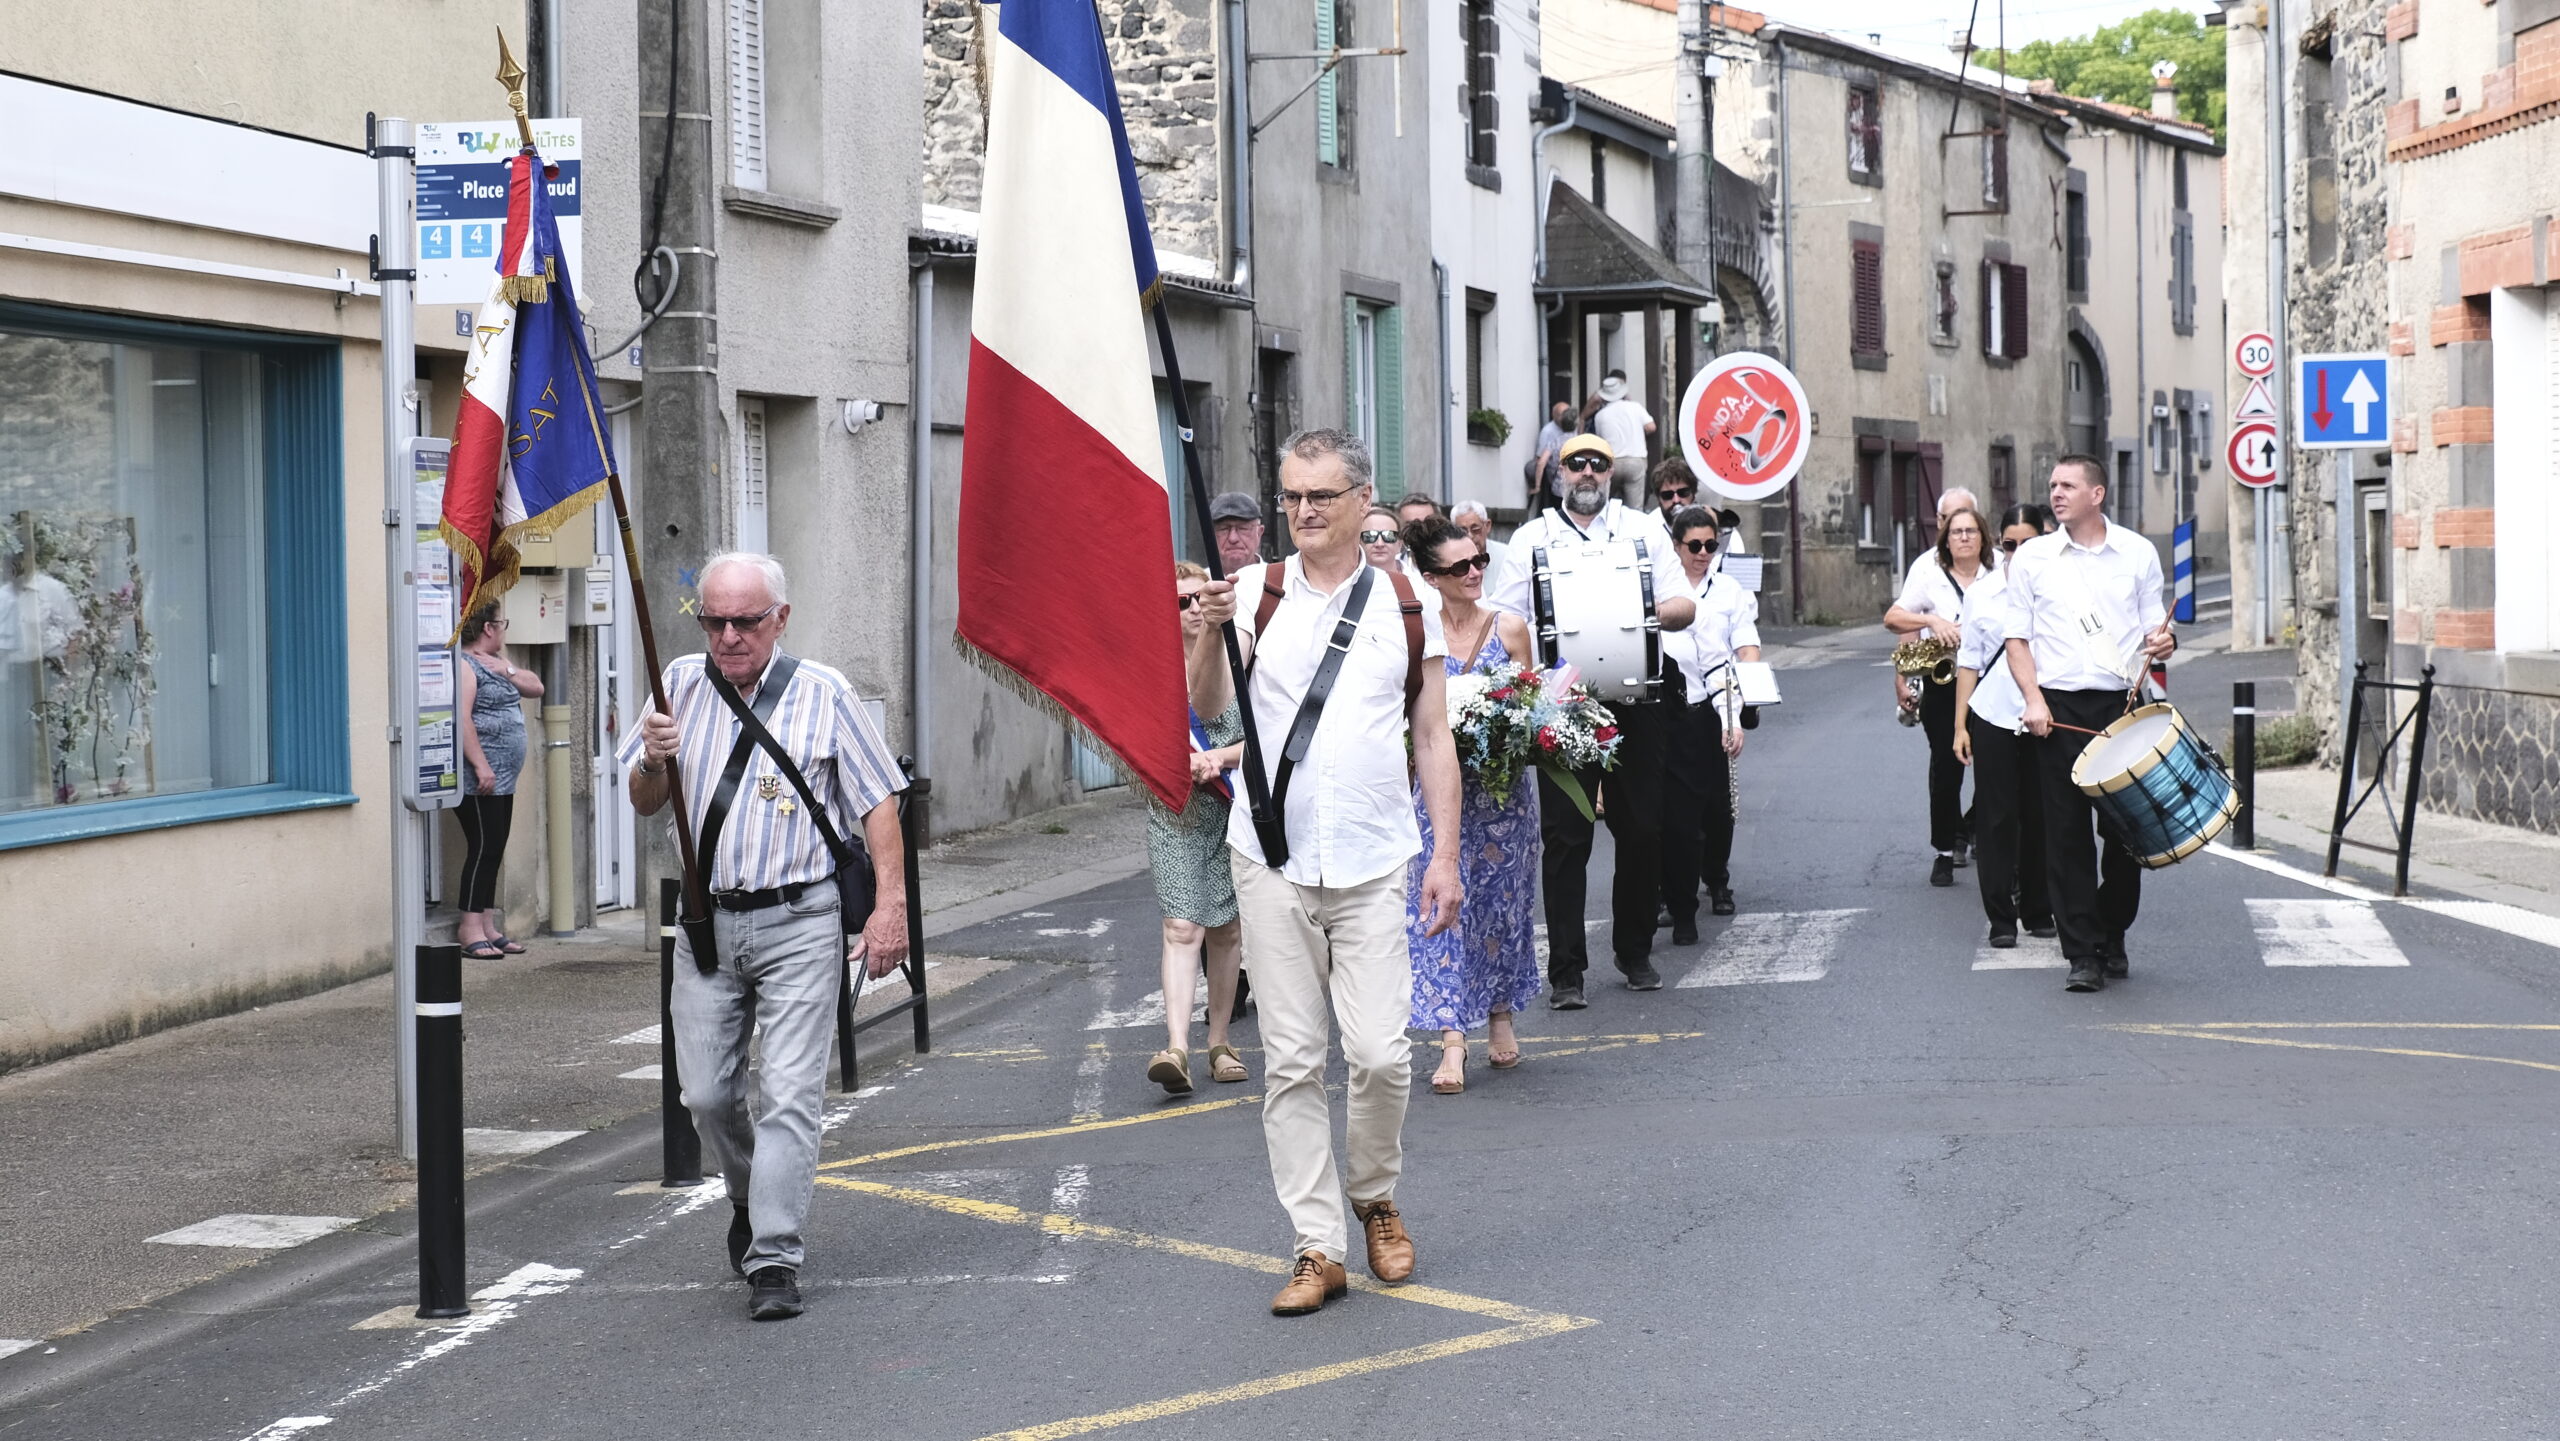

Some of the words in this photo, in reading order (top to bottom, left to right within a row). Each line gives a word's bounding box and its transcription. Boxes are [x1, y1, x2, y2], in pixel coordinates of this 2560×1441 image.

[457, 131, 501, 153] RLV
[504, 133, 576, 149] MOILITÉS
[463, 180, 504, 199] Place
[546, 177, 576, 196] aud
[429, 226, 443, 245] 4
[470, 225, 483, 244] 4
[462, 314, 469, 332] 2
[633, 348, 640, 365] 2
[2245, 346, 2270, 364] 30
[1722, 394, 1754, 440] MOZAC
